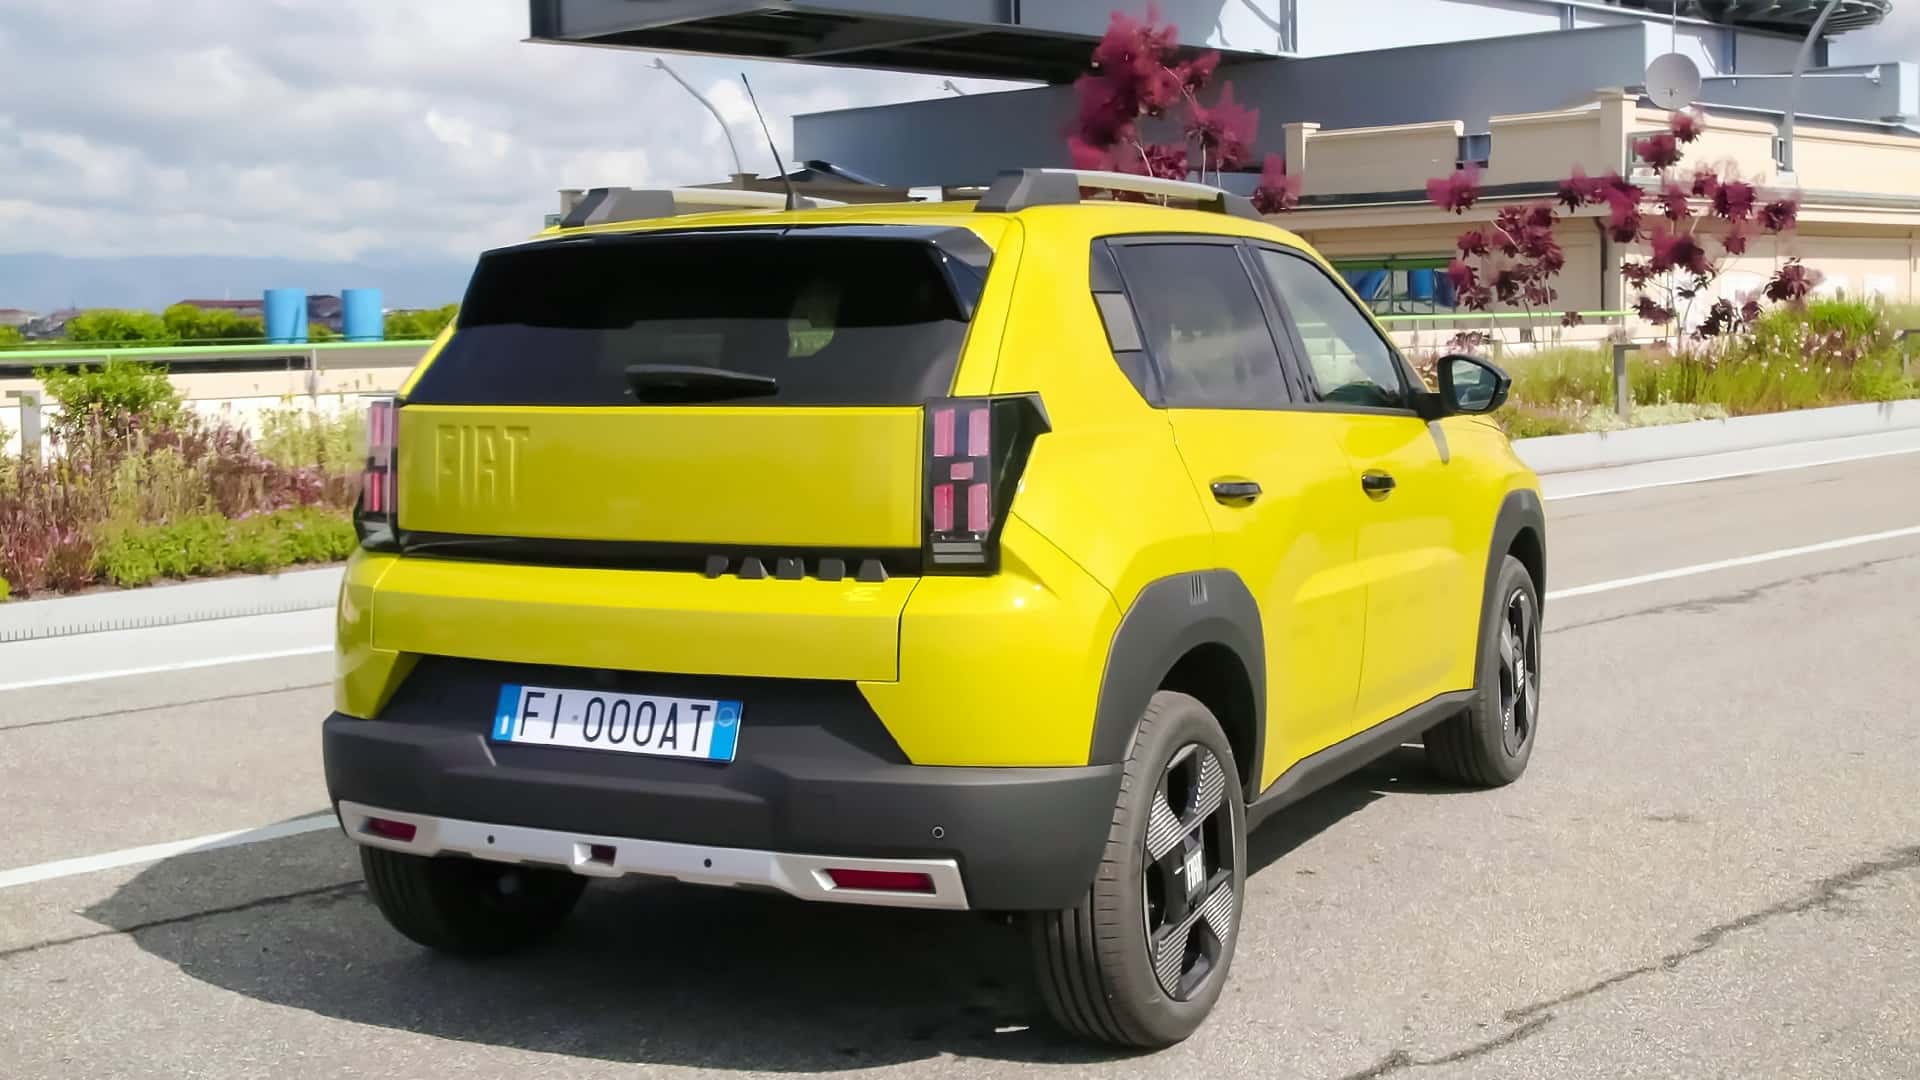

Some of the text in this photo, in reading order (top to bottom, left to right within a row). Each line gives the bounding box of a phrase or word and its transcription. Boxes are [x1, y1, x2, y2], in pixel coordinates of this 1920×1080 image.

[435, 424, 529, 507] FIAT
[520, 691, 712, 753] FI 000AT
